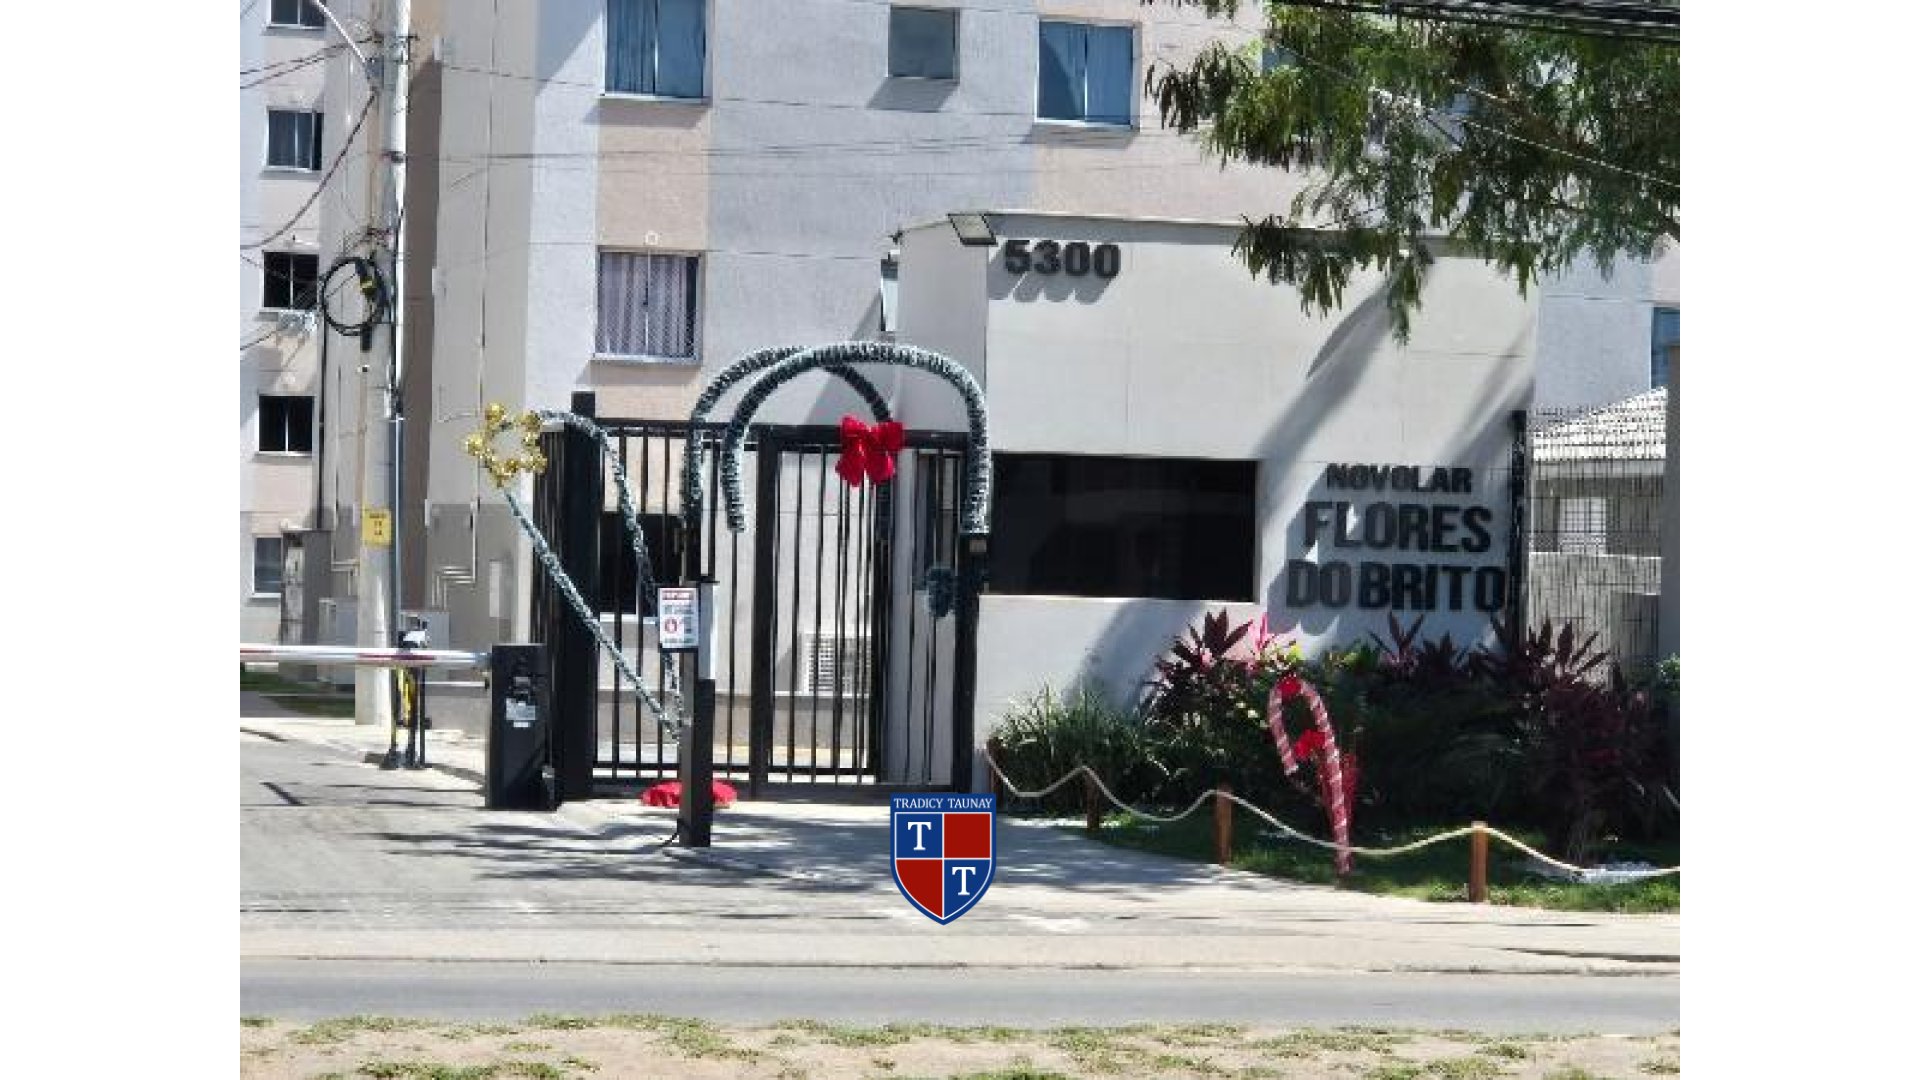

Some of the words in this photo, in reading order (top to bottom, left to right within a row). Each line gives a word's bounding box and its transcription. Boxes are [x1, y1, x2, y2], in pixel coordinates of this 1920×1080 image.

[1005, 239, 1121, 279] 5300
[1326, 463, 1472, 493] NOVOLAR
[1304, 501, 1492, 553] FLORES
[1286, 558, 1351, 609] DO
[1358, 560, 1506, 612] BRITO
